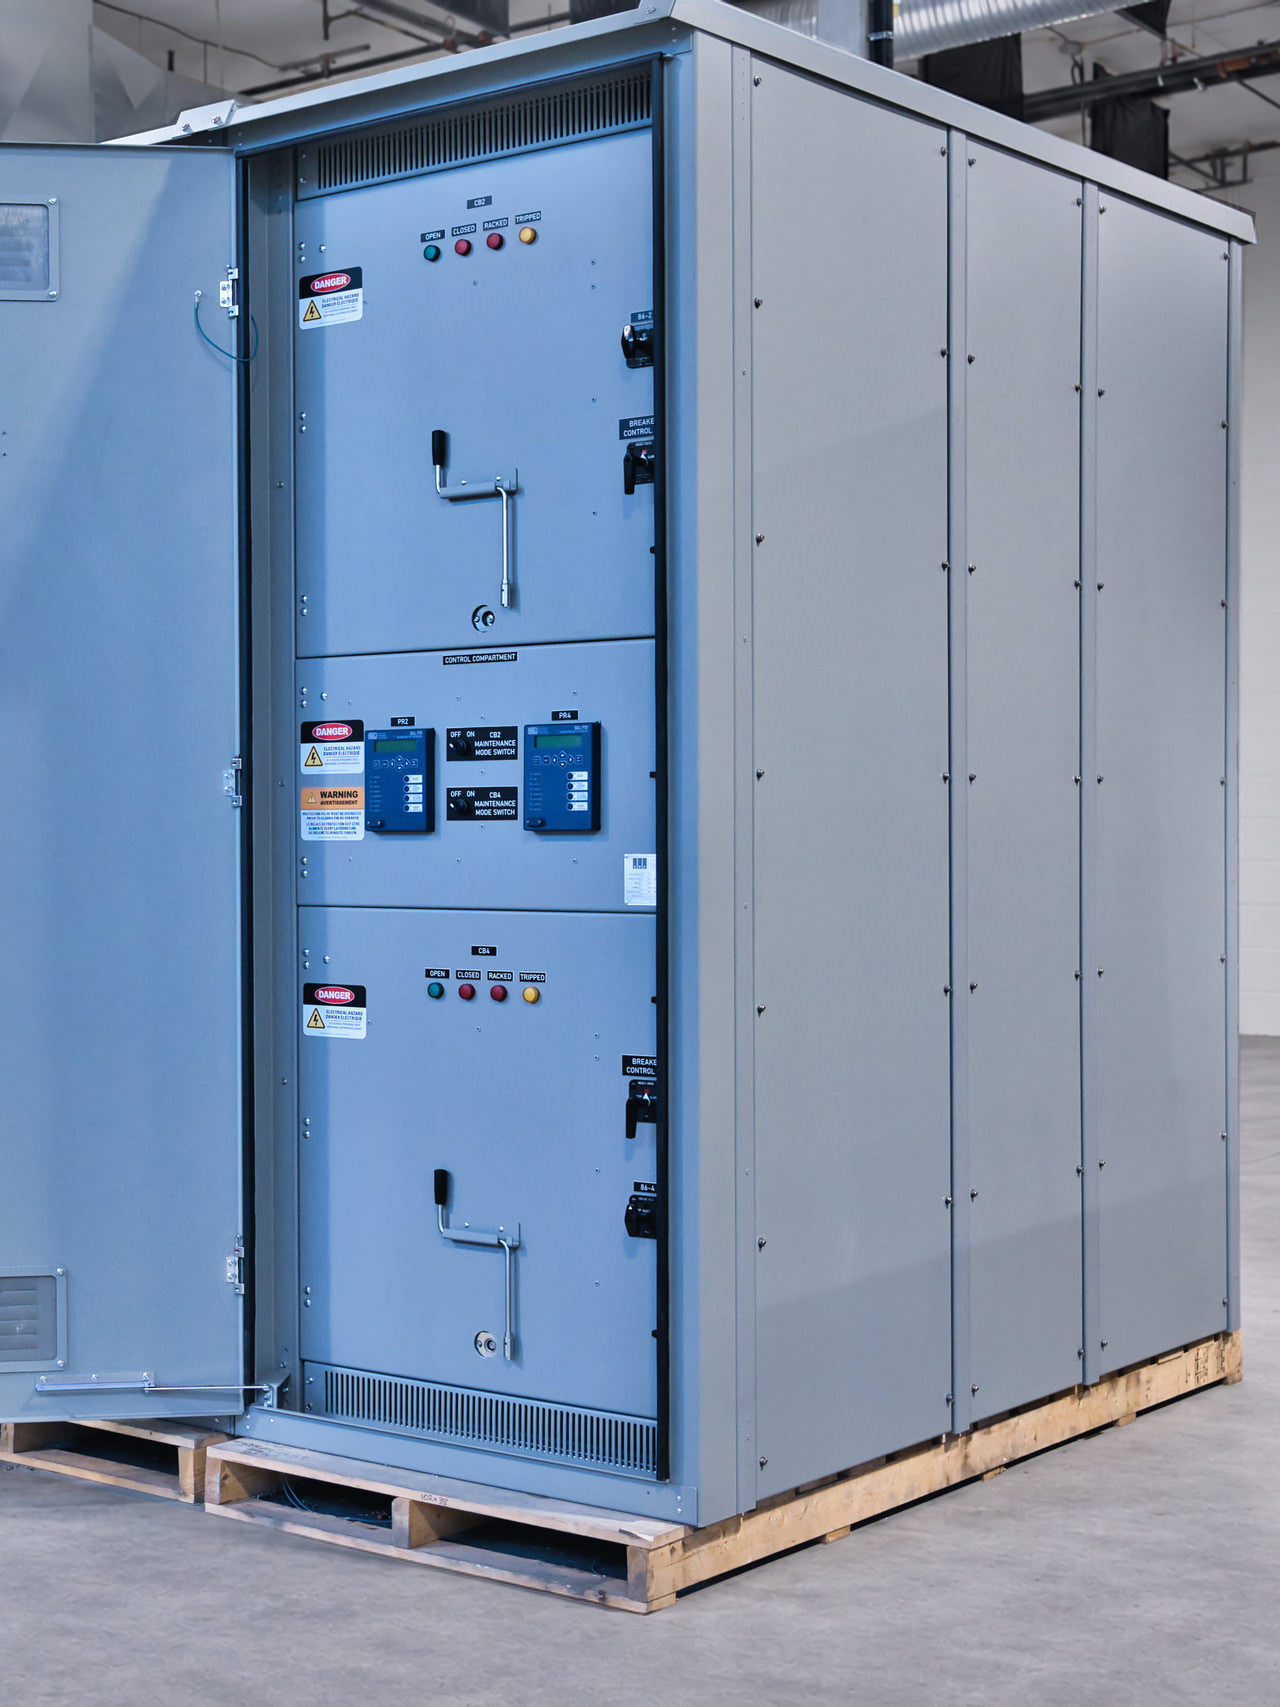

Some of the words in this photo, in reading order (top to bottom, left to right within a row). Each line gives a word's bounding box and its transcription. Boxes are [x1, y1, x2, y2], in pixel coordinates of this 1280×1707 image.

[473, 198, 486, 206] CB2
[516, 212, 540, 223] TRIPPED
[484, 219, 507, 229] RACKED
[452, 225, 475, 235] CLOSED
[425, 232, 441, 240] OPEN
[314, 276, 347, 289] DANGER
[629, 418, 655, 427] BREAKE
[623, 428, 653, 437] CONTROL
[445, 656, 471, 664] CONTROL
[472, 653, 516, 662] COMPARTMENT
[316, 727, 348, 736] DANGER
[466, 730, 475, 738] ON
[320, 790, 358, 799] WARNING
[450, 790, 461, 798] OFF
[478, 947, 490, 955] CB4
[457, 971, 479, 979] CLOSED
[489, 972, 512, 980] RACKED
[520, 973, 545, 981] TRIPPED
[318, 991, 351, 1000] DANGER
[632, 1058, 657, 1066] BREAKE
[626, 1067, 655, 1075] CONTROL
